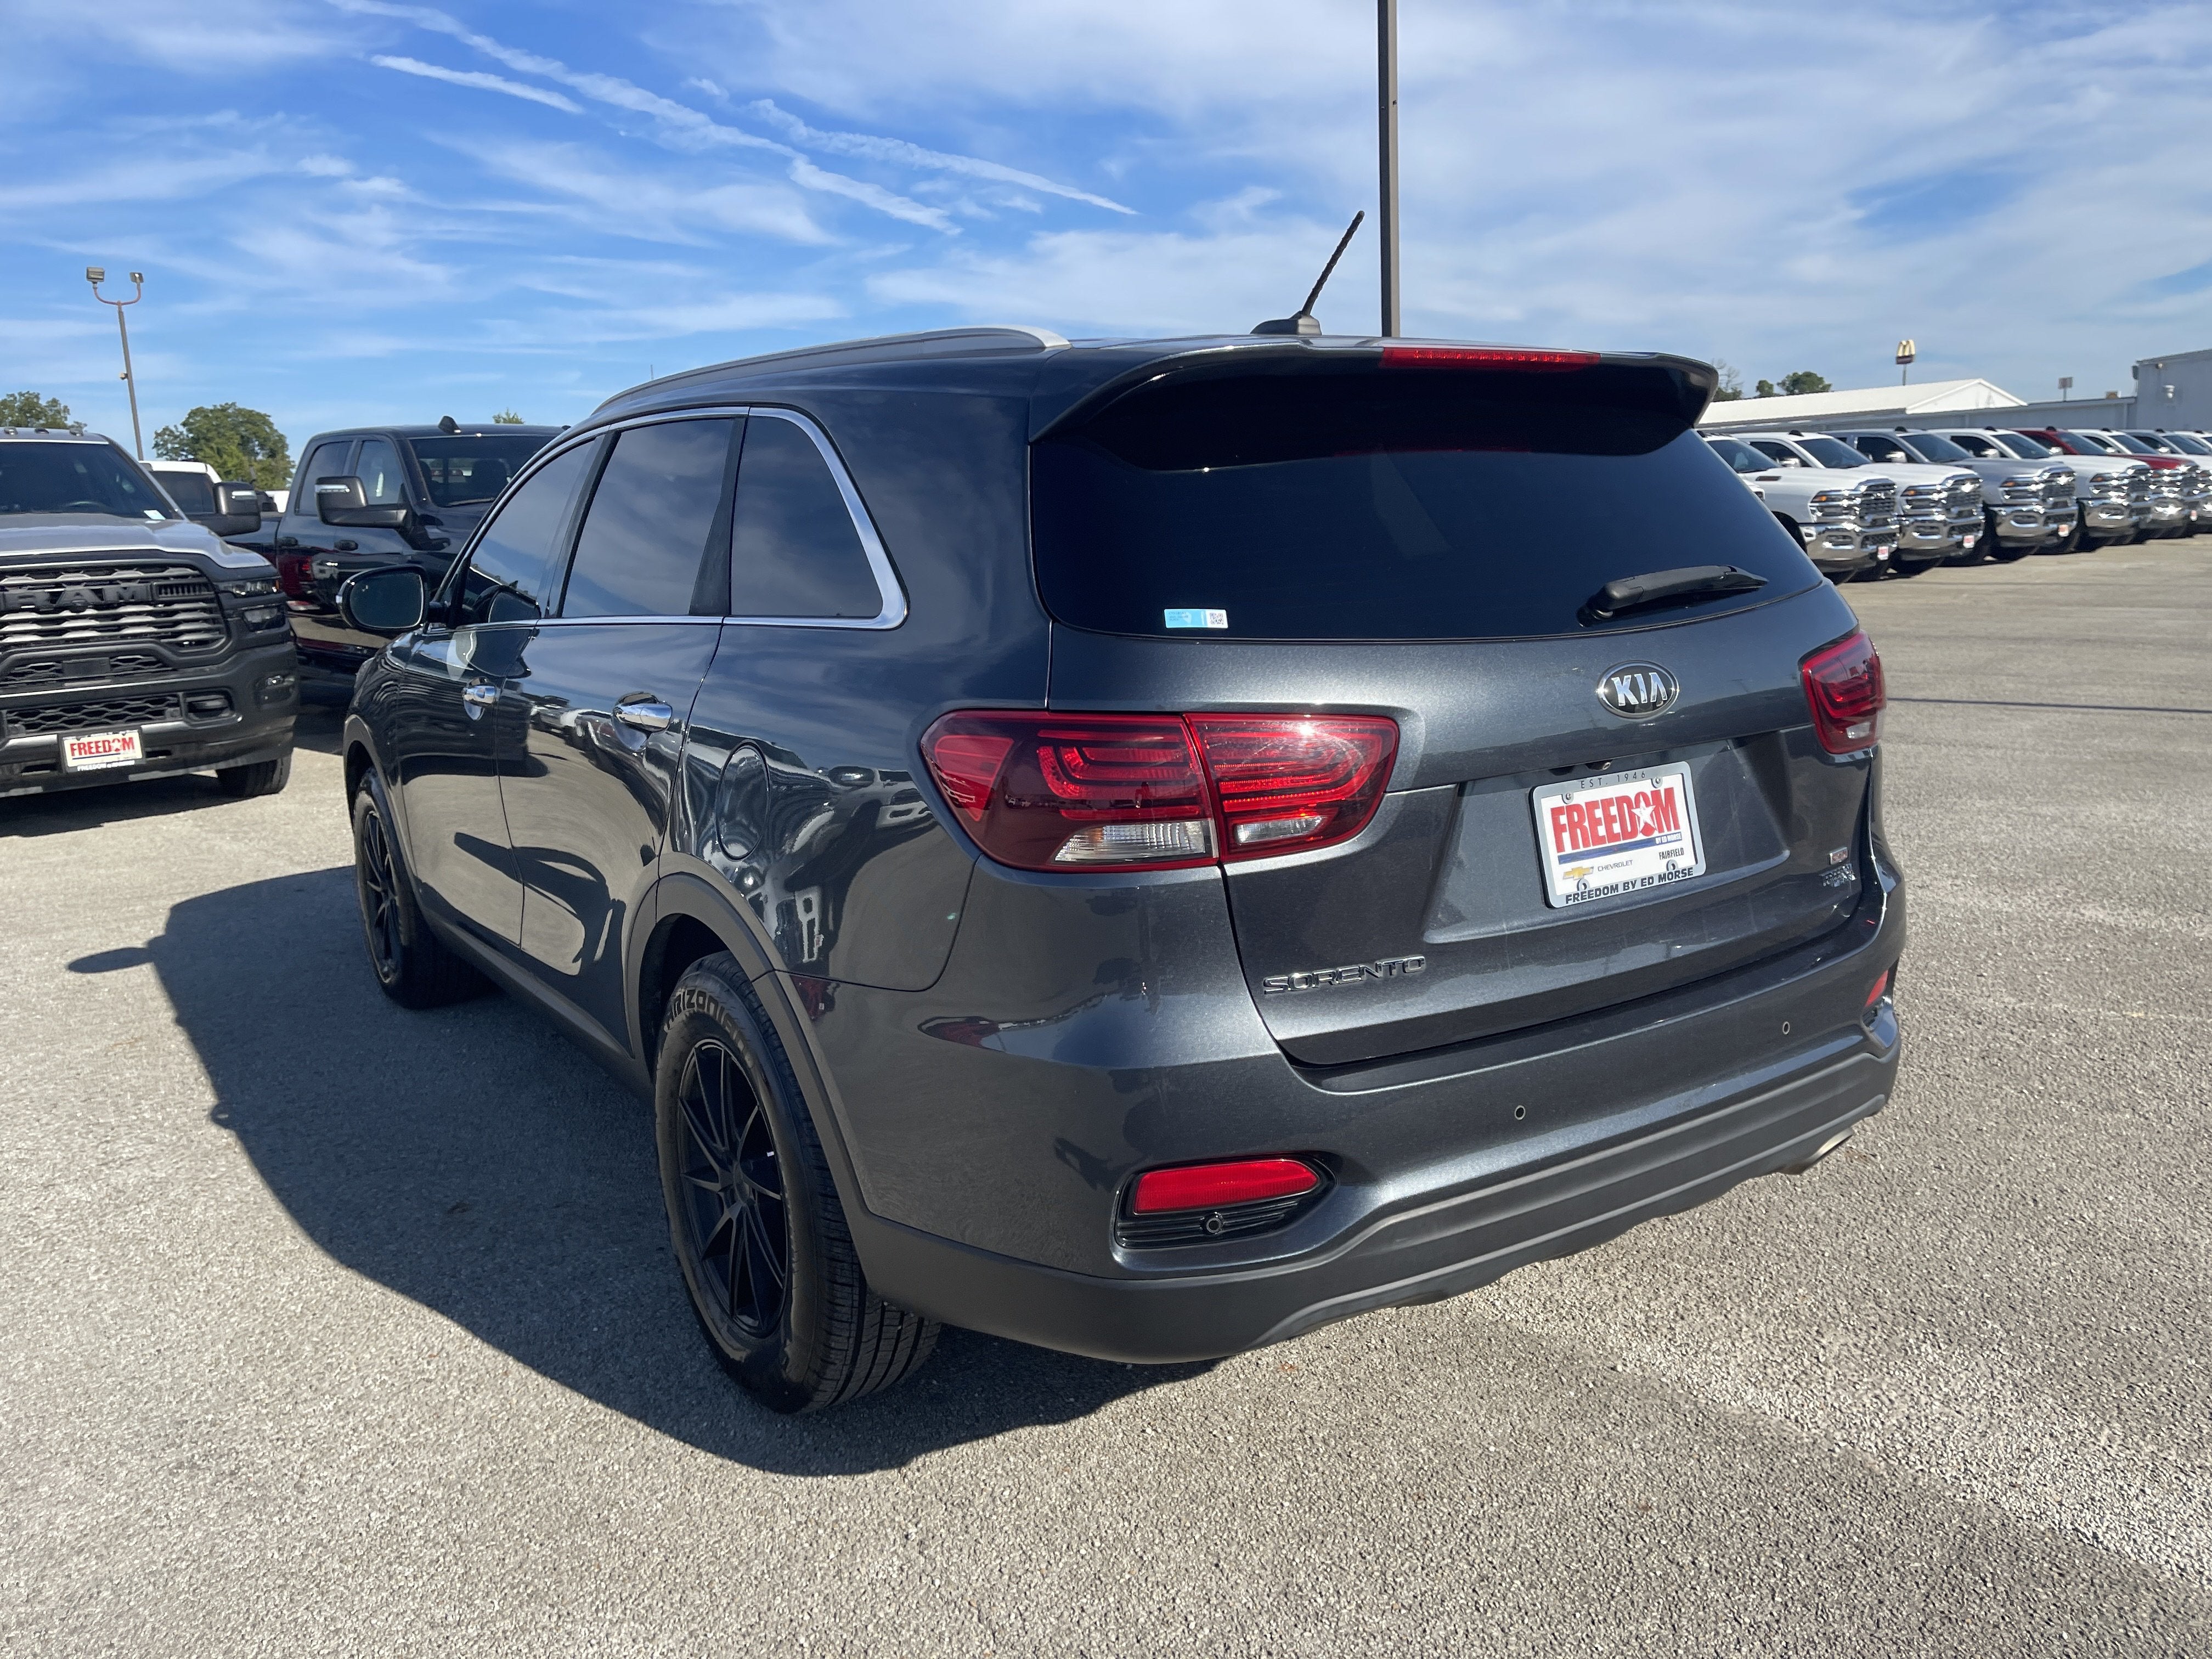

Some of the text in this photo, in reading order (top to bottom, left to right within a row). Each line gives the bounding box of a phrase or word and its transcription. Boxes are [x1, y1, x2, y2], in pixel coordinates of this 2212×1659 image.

[1611, 672, 1668, 707] KIA
[70, 737, 134, 757] FREEDOM
[1581, 770, 1646, 789] EST. 1946
[1550, 787, 1680, 854] FREEDOM
[1667, 832, 1682, 842] MORSE
[1658, 848, 1685, 860] FAIRFIELD
[1597, 860, 1633, 872] CHEVROLET
[1565, 867, 1694, 904] FREEDOM BY ED MORSE
[1263, 956, 1426, 995] SORENTO
